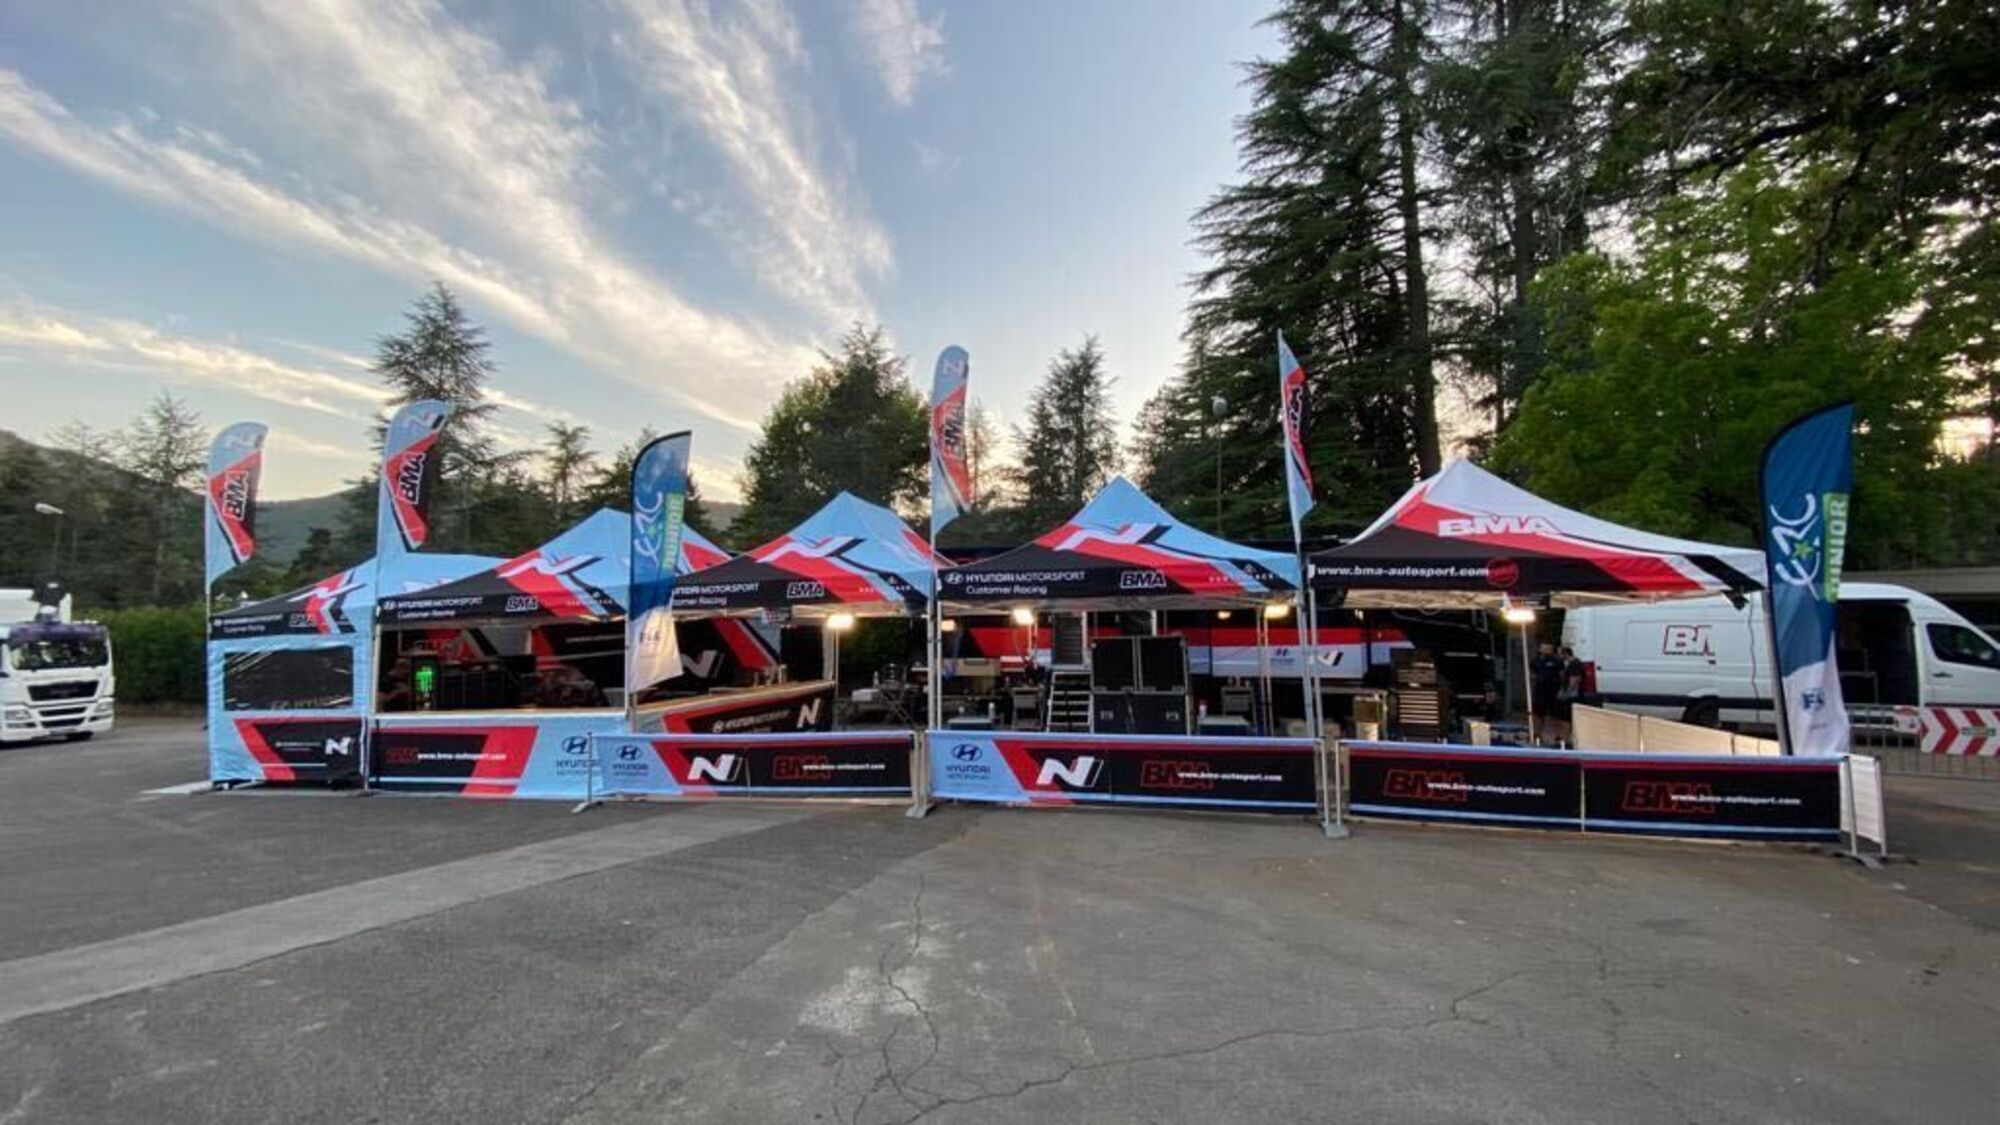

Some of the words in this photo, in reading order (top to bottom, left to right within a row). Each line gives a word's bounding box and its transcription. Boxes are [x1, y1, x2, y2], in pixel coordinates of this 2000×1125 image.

[396, 451, 426, 504] BMA
[222, 470, 249, 521] BMA
[1437, 515, 1563, 537] BMA
[966, 574, 1014, 583] HYUNDAI
[1015, 571, 1085, 582] MOTORSPORT
[1120, 571, 1167, 589] BMA
[1317, 565, 1489, 579] www.bma-autosport.com
[787, 582, 824, 598] BMA
[966, 584, 1010, 594] Customer
[1013, 584, 1048, 596] Racing
[797, 698, 821, 728] N
[325, 737, 351, 755] N
[688, 754, 743, 782] N
[1036, 756, 1104, 787] N
[1427, 780, 1546, 797] www.bma-autosport.com
[1671, 792, 1801, 806] www.bma-autosport.com
